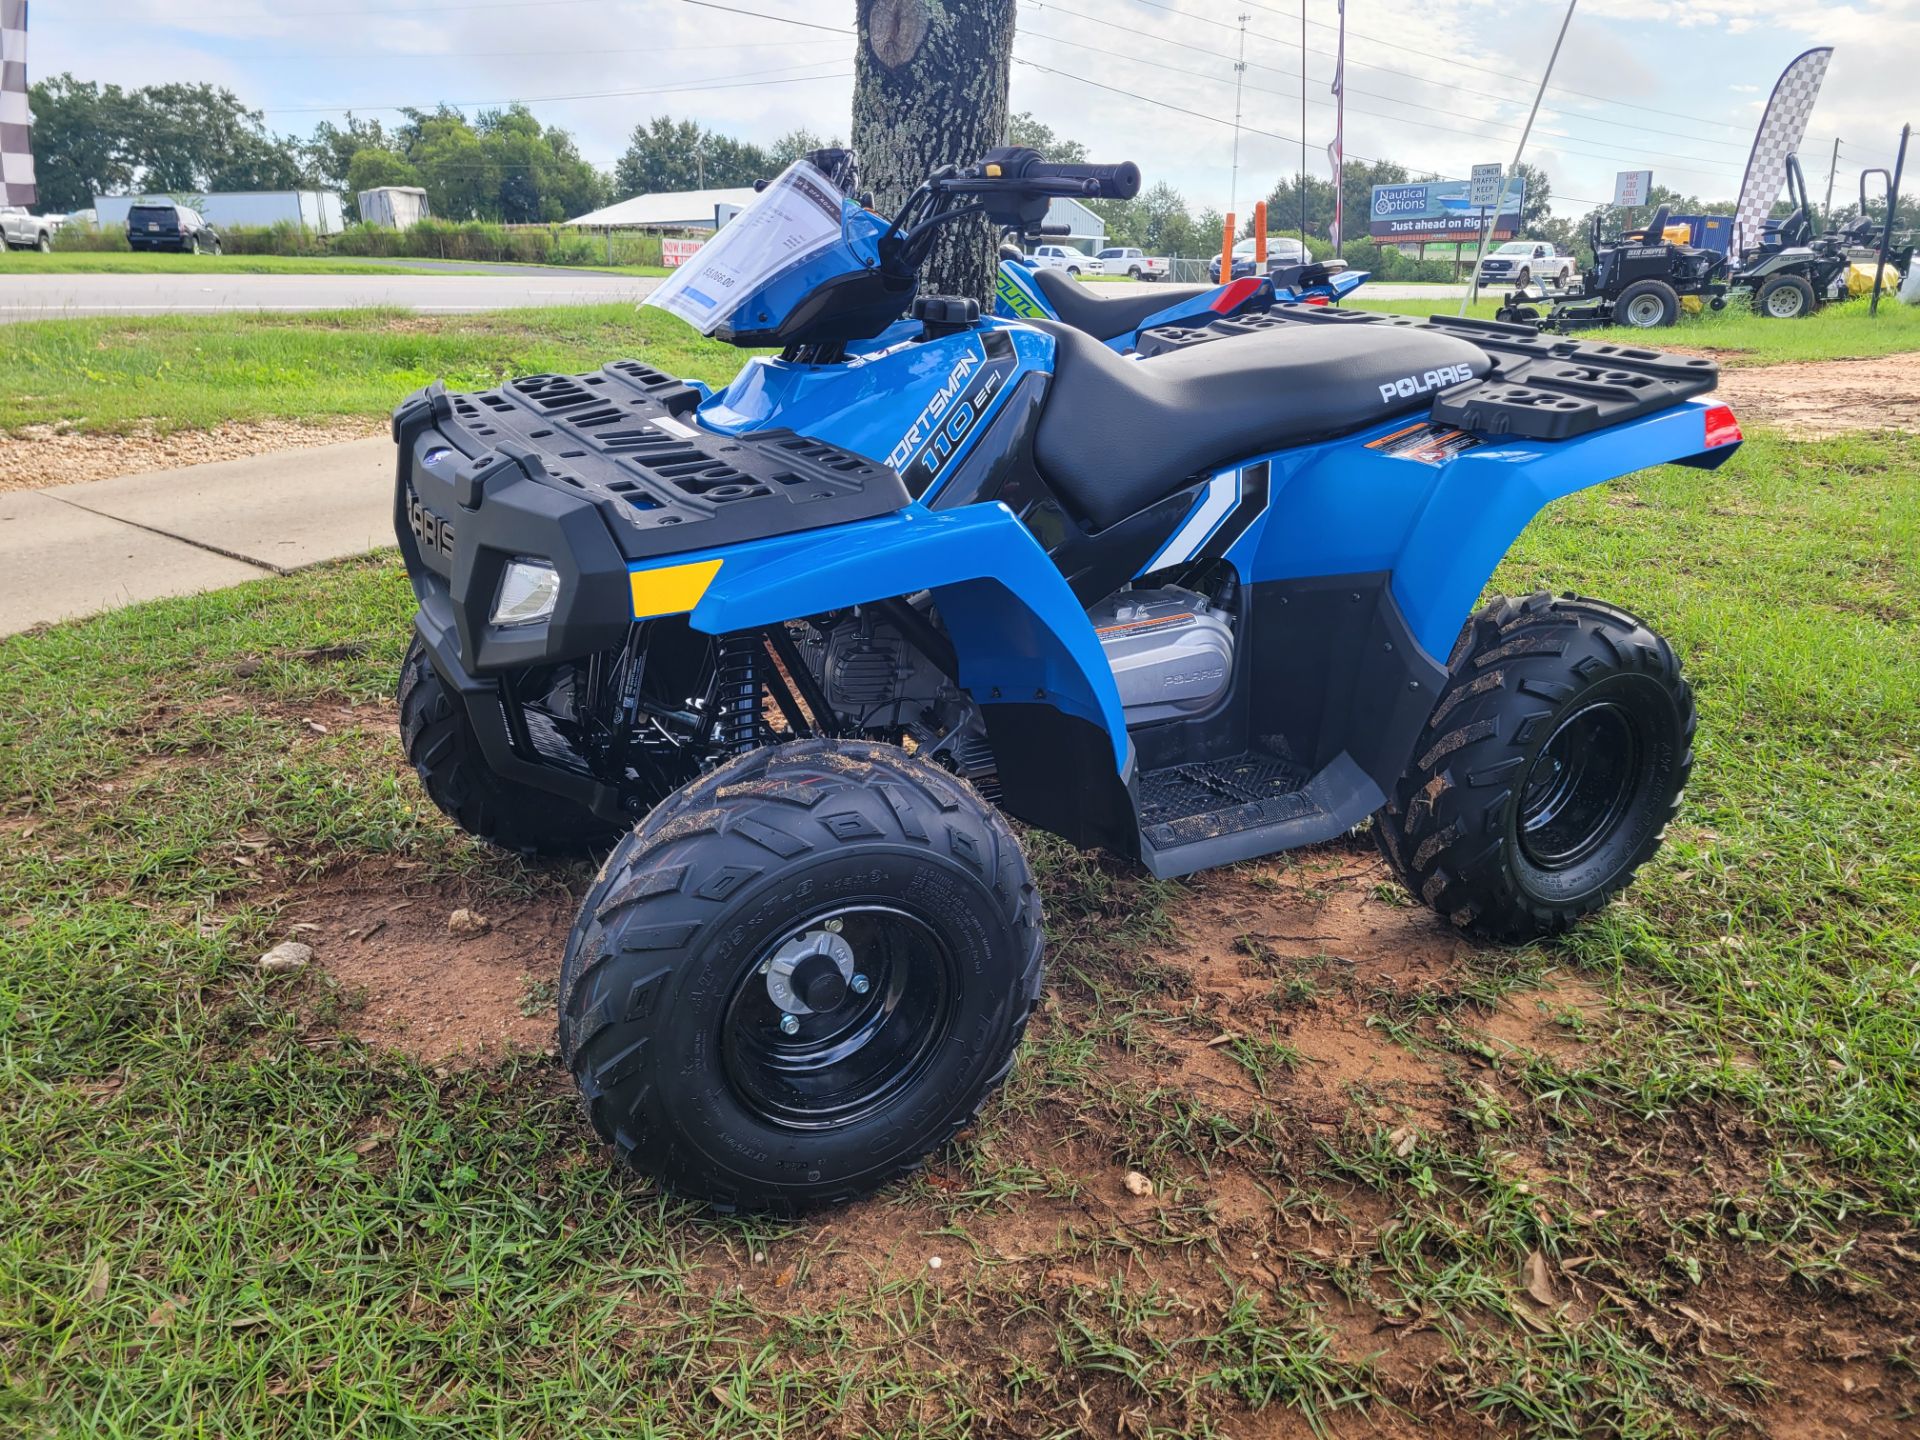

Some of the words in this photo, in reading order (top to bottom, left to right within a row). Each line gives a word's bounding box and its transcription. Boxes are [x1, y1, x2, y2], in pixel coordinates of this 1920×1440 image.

[1474, 167, 1499, 176] SLOWER
[1473, 176, 1499, 185] TRAFFIC
[1379, 187, 1426, 200] Nautical
[1474, 193, 1494, 202] RIGHT
[1622, 189, 1638, 197] ADULT
[1375, 198, 1425, 215] Options
[1391, 221, 1413, 231] Just
[1414, 219, 1446, 230] ahead
[1448, 219, 1461, 228] on
[664, 241, 679, 253] NOW
[681, 242, 704, 253] HIRIN
[995, 277, 1034, 318] OUTL
[1378, 362, 1473, 404] POLARIS
[882, 349, 979, 470] PORTSMAN
[921, 401, 975, 474] 110
[973, 369, 1001, 409] EFI
[1163, 667, 1224, 687] POLARIS
